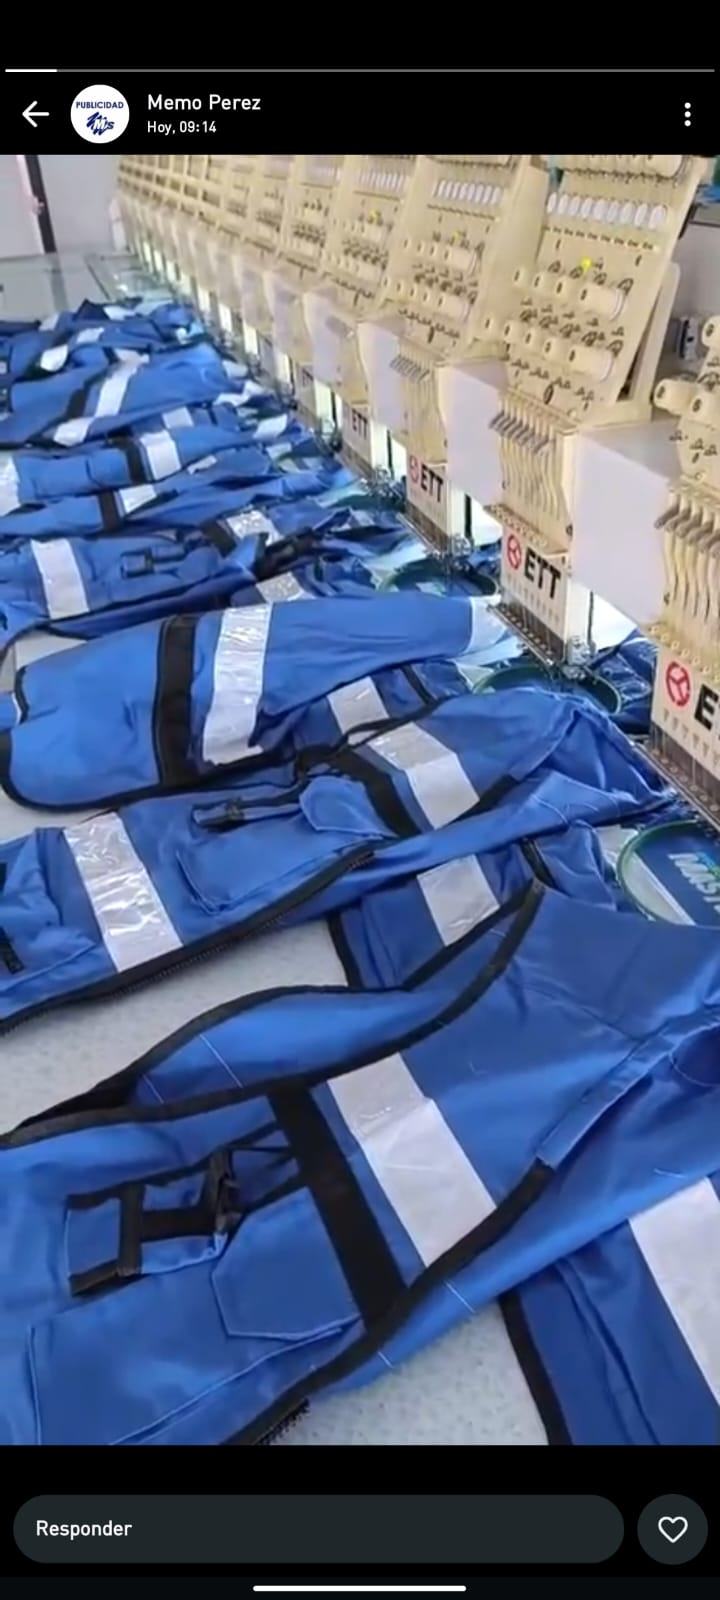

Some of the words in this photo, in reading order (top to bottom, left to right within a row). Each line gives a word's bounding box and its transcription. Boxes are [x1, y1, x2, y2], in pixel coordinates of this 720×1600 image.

[352, 409, 368, 439] ETT
[420, 464, 444, 503] ETT
[524, 547, 561, 599] ETT
[694, 683, 720, 731] E
